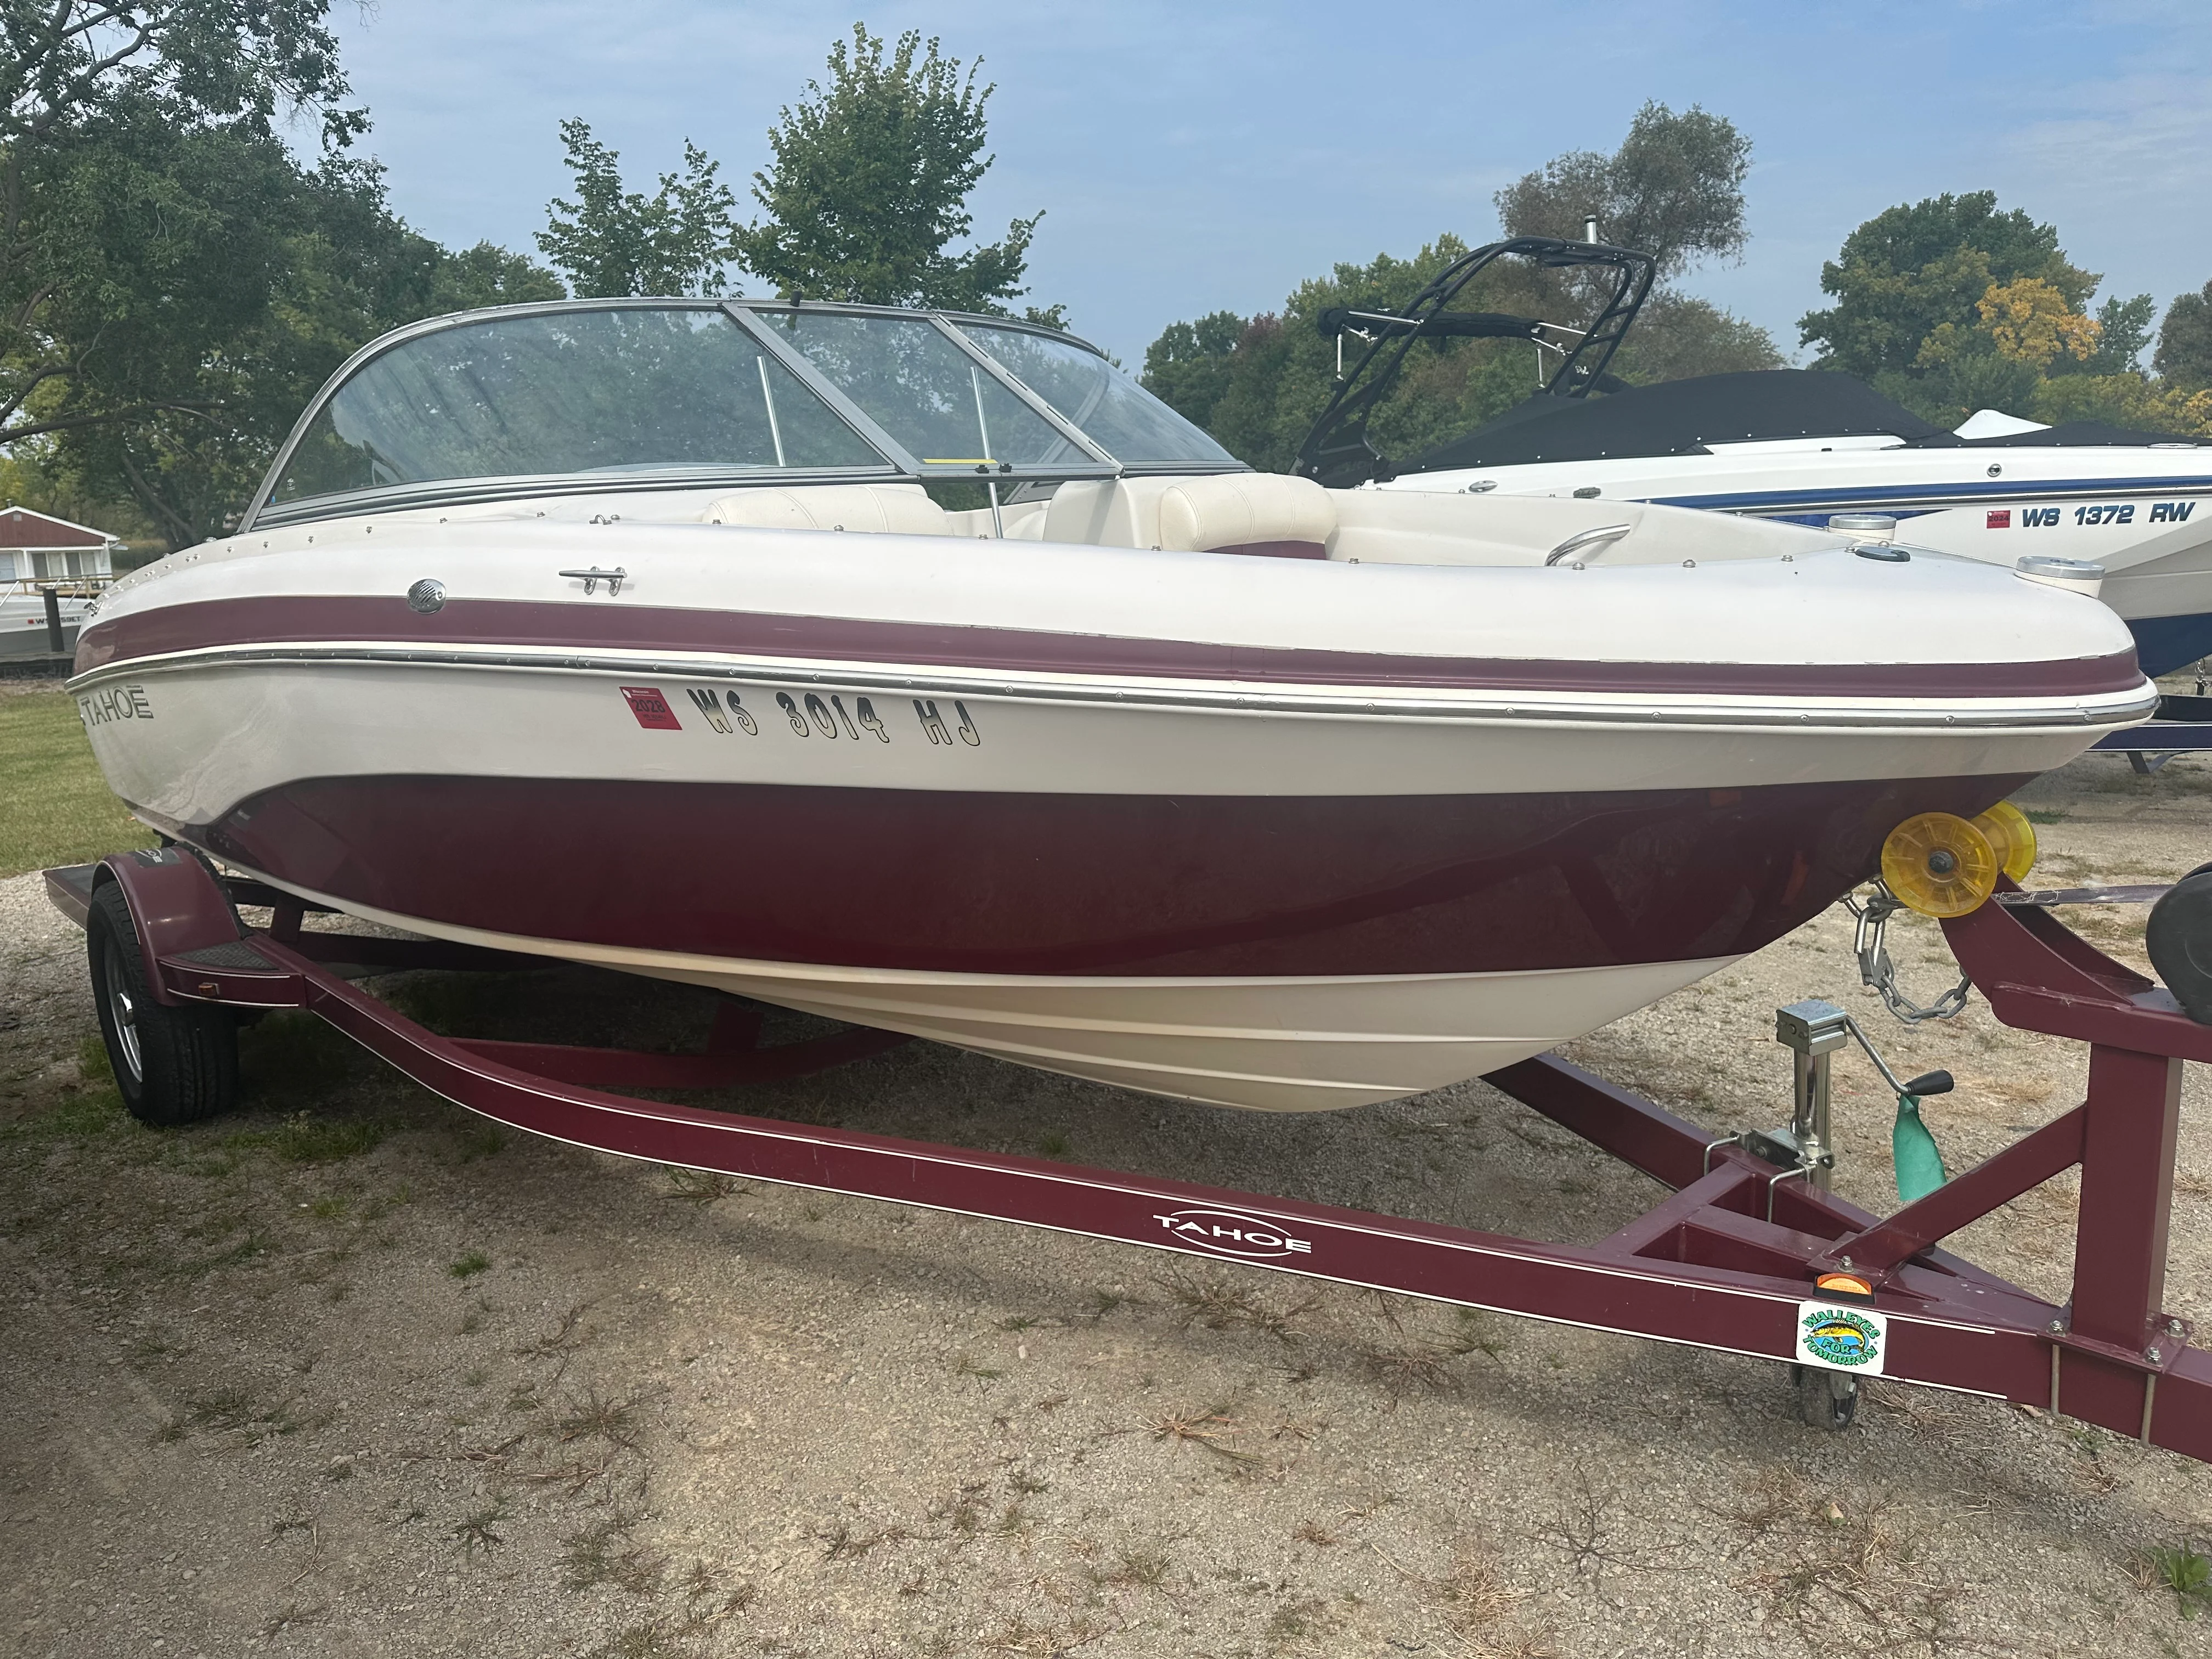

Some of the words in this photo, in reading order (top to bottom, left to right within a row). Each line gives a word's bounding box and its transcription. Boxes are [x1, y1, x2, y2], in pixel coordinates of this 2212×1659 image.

[2022, 508, 2061, 527] WS
[2074, 505, 2135, 525] 1372
[2149, 501, 2196, 523] RW
[80, 685, 154, 726] TAHOE
[631, 699, 665, 713] 2028
[686, 689, 758, 736] WS
[776, 691, 890, 743] 3014
[913, 699, 981, 746] HJ
[1153, 1214, 1312, 1254] TAHOE
[1802, 1310, 1881, 1339] WALLEYES
[1803, 1334, 1878, 1365] TOMORROW
[1821, 1338, 1852, 1355] FOR
